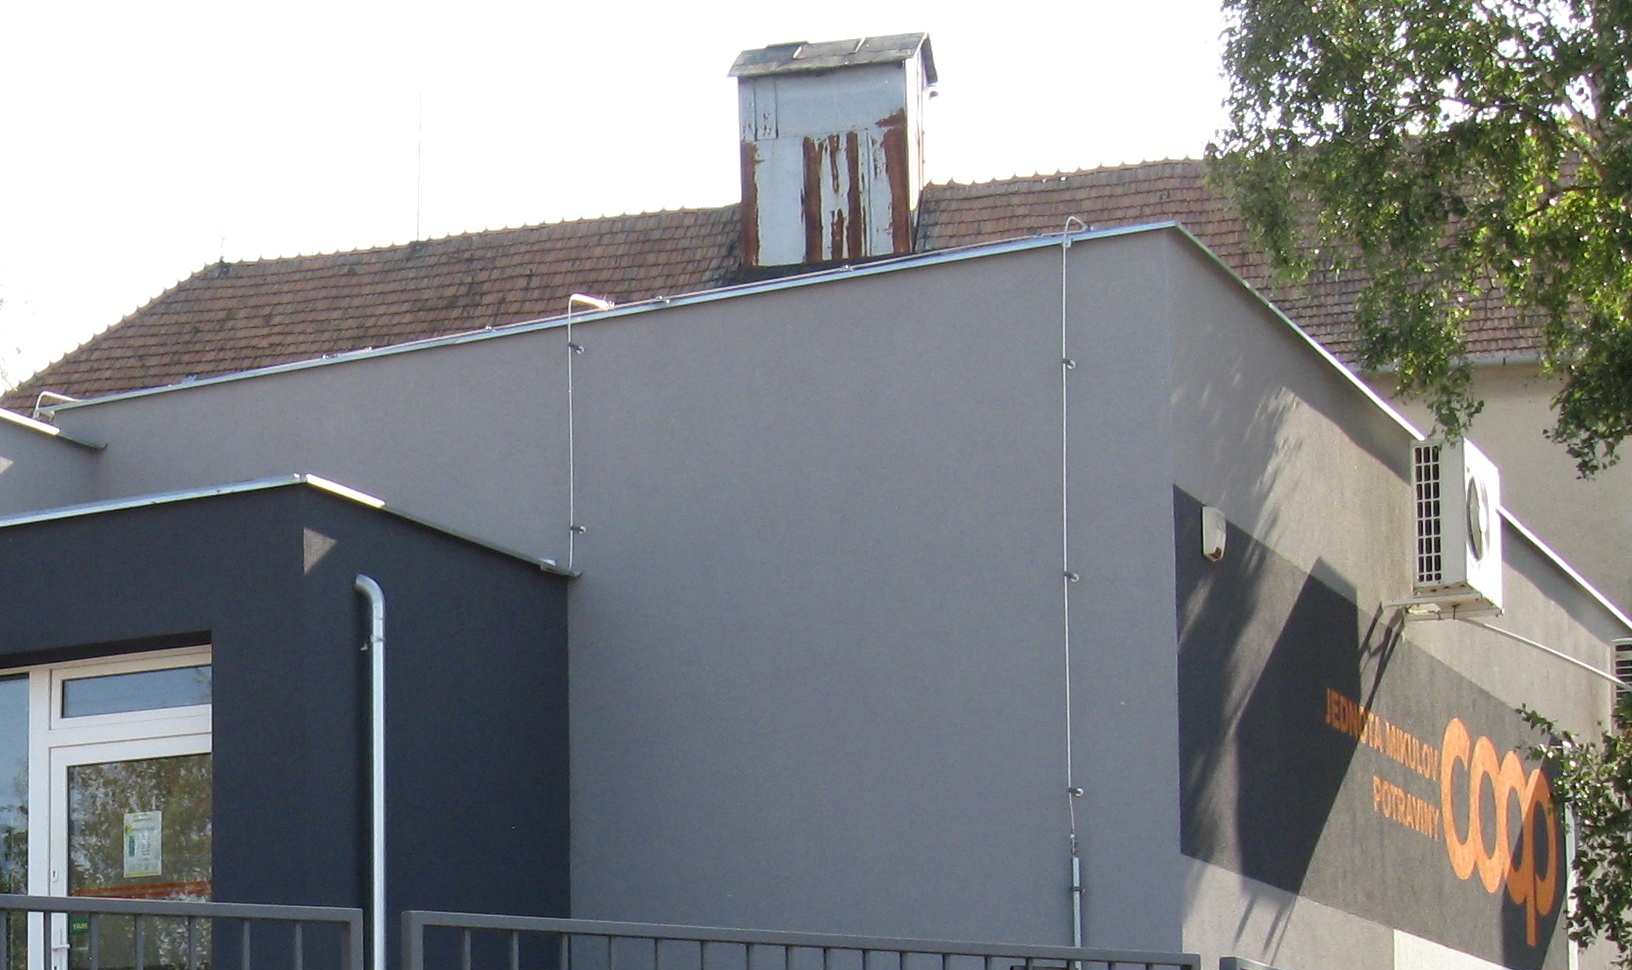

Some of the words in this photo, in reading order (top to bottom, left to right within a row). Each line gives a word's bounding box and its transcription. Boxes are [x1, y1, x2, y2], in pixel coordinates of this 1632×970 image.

[1326, 687, 1383, 753] JEDNOTA
[1385, 721, 1438, 781] MIKULOV
[1373, 775, 1440, 841] POTRAVINY
[1441, 717, 1557, 947] coop
